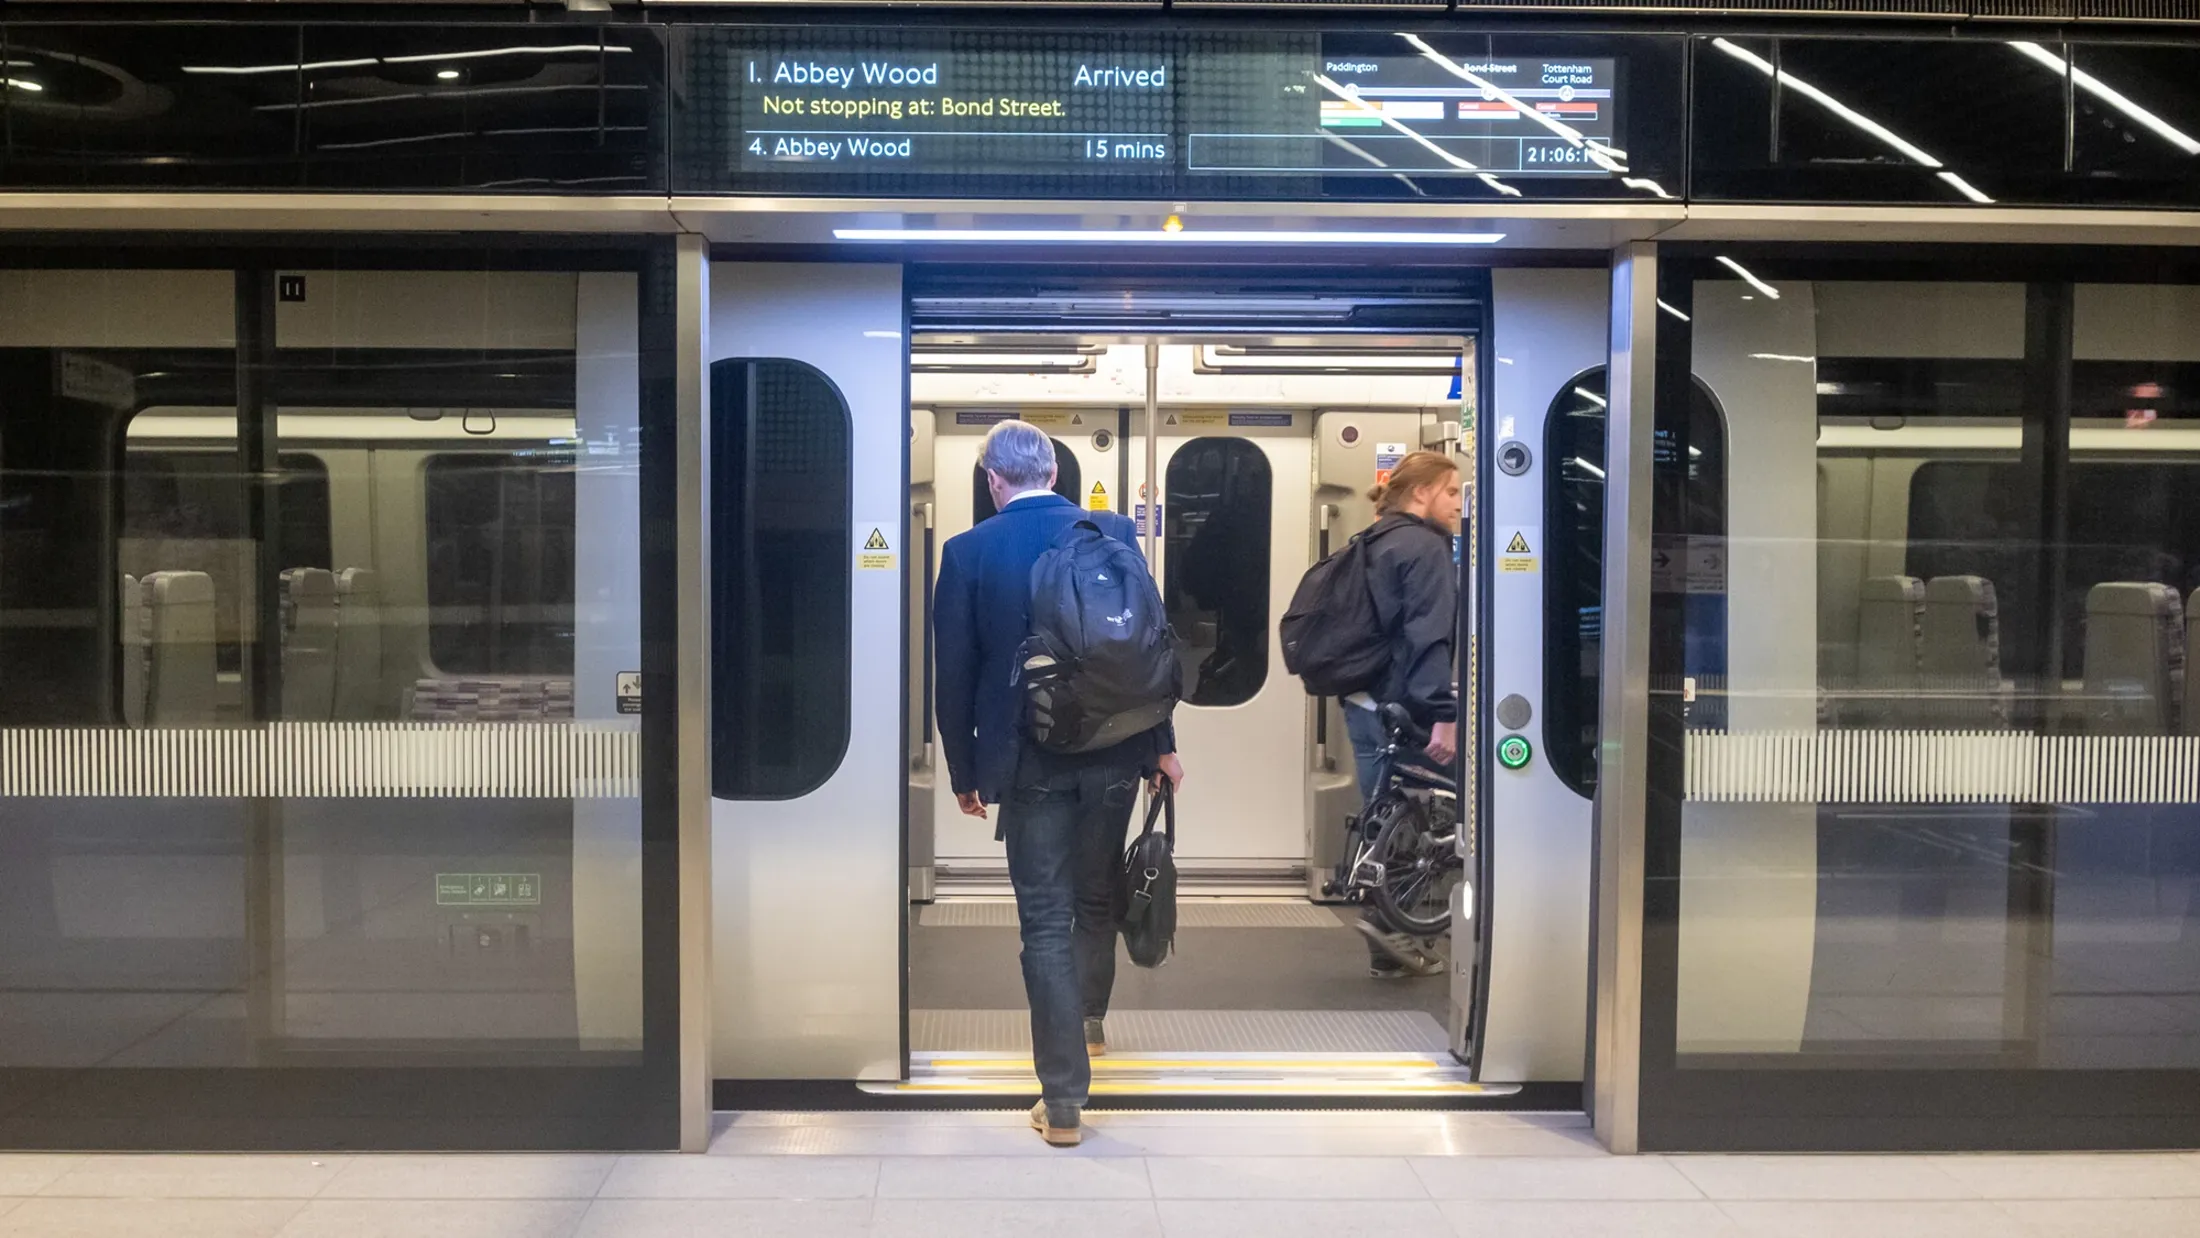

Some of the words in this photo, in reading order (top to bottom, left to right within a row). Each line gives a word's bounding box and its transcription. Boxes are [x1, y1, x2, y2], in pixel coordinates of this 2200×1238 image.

[749, 61, 762, 83] 1.
[774, 61, 855, 88] Abbey
[862, 61, 938, 85] Wood
[1073, 64, 1166, 87] Arrived
[1326, 61, 1378, 73] Paddington
[1542, 63, 1593, 74] Tottenham
[1541, 74, 1568, 84] Court
[1569, 74, 1593, 84] Road
[763, 95, 805, 115] Not
[810, 97, 903, 119] stopping
[908, 97, 935, 116] at:
[941, 97, 994, 117] Bond
[1000, 97, 1066, 117] Street.
[748, 137, 767, 156] 4.
[774, 136, 842, 160] Abbey
[847, 136, 911, 157] Wood
[1086, 139, 1109, 158] 15
[1115, 139, 1166, 159] mins
